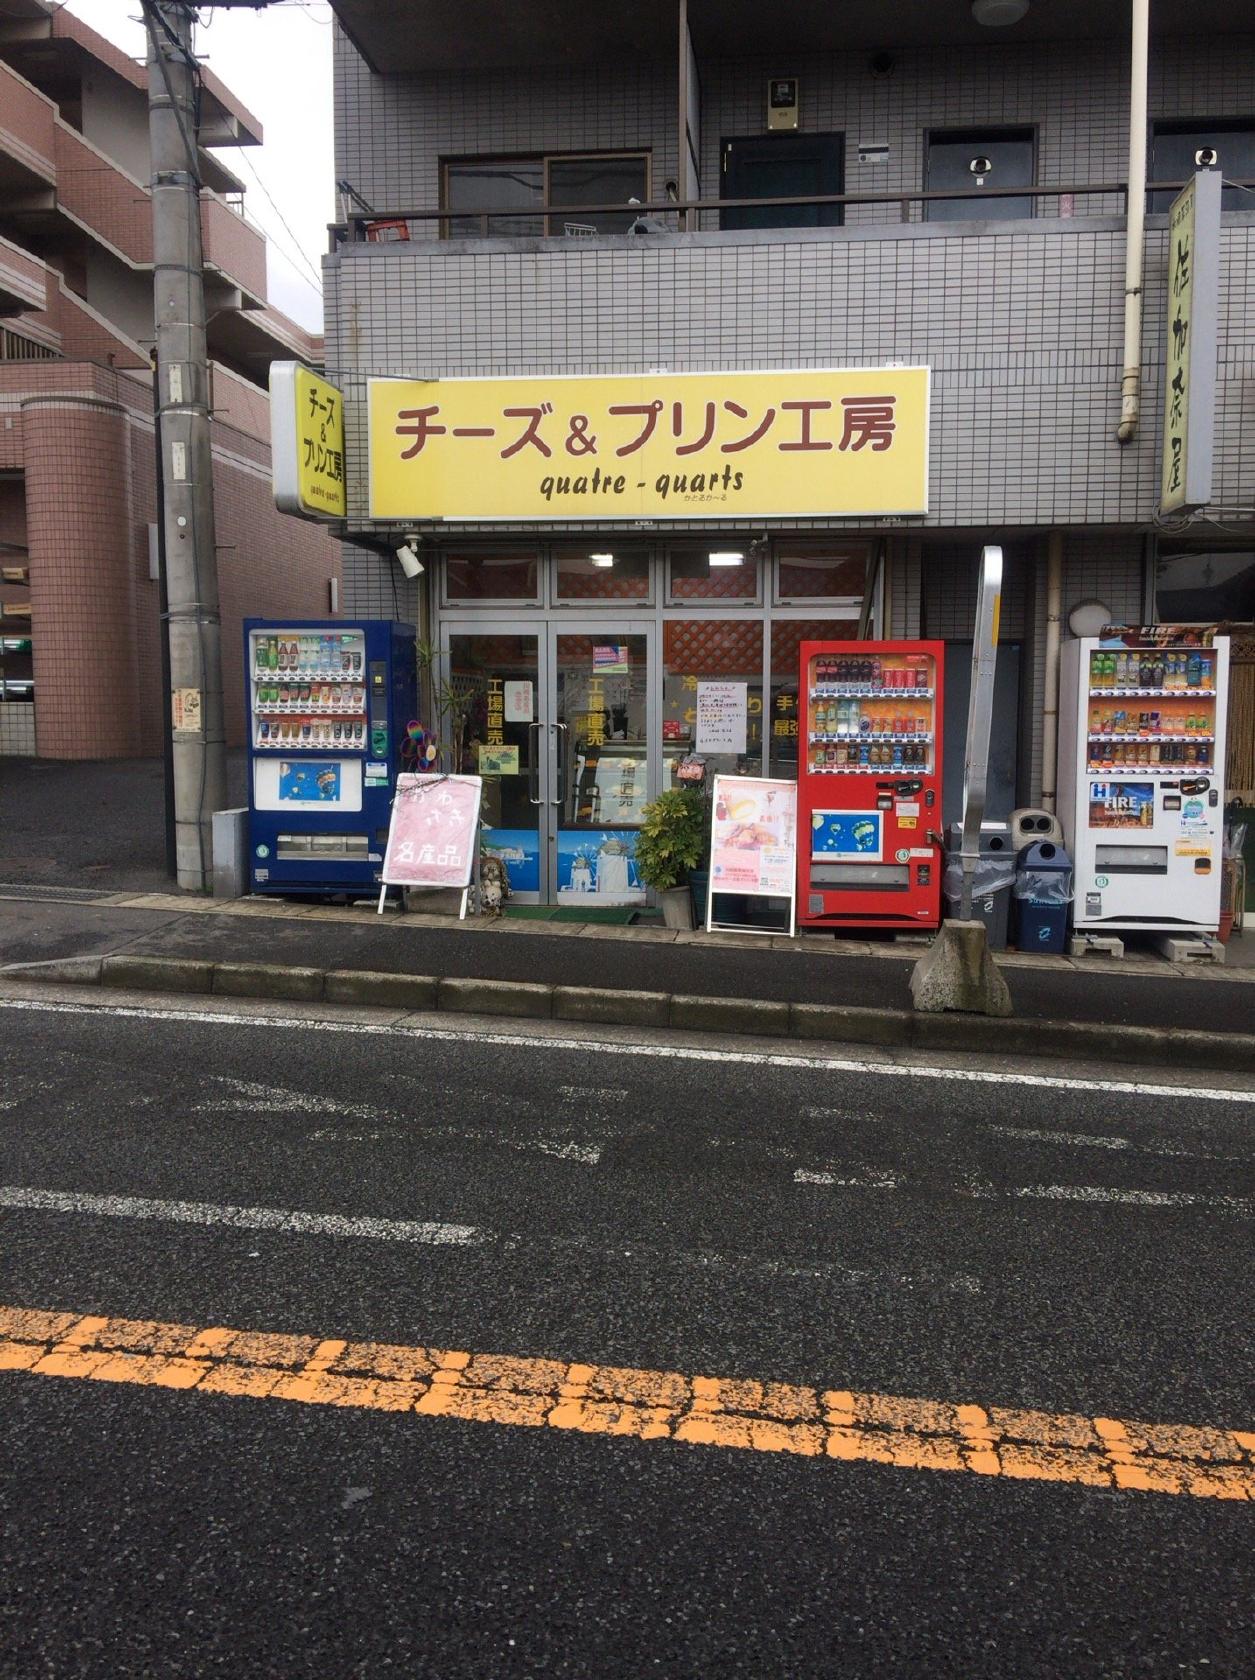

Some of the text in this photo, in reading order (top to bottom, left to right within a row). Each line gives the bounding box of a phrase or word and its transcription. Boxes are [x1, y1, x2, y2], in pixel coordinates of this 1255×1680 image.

[303, 437, 343, 482] プリン工房
[540, 467, 626, 501] quatre
[655, 464, 744, 499] quarts
[1140, 626, 1178, 635] FIRE
[487, 679, 504, 745] 工場直売
[586, 678, 605, 746] 工場直売
[1104, 796, 1138, 808] FIRE
[393, 842, 461, 866] 名産品
